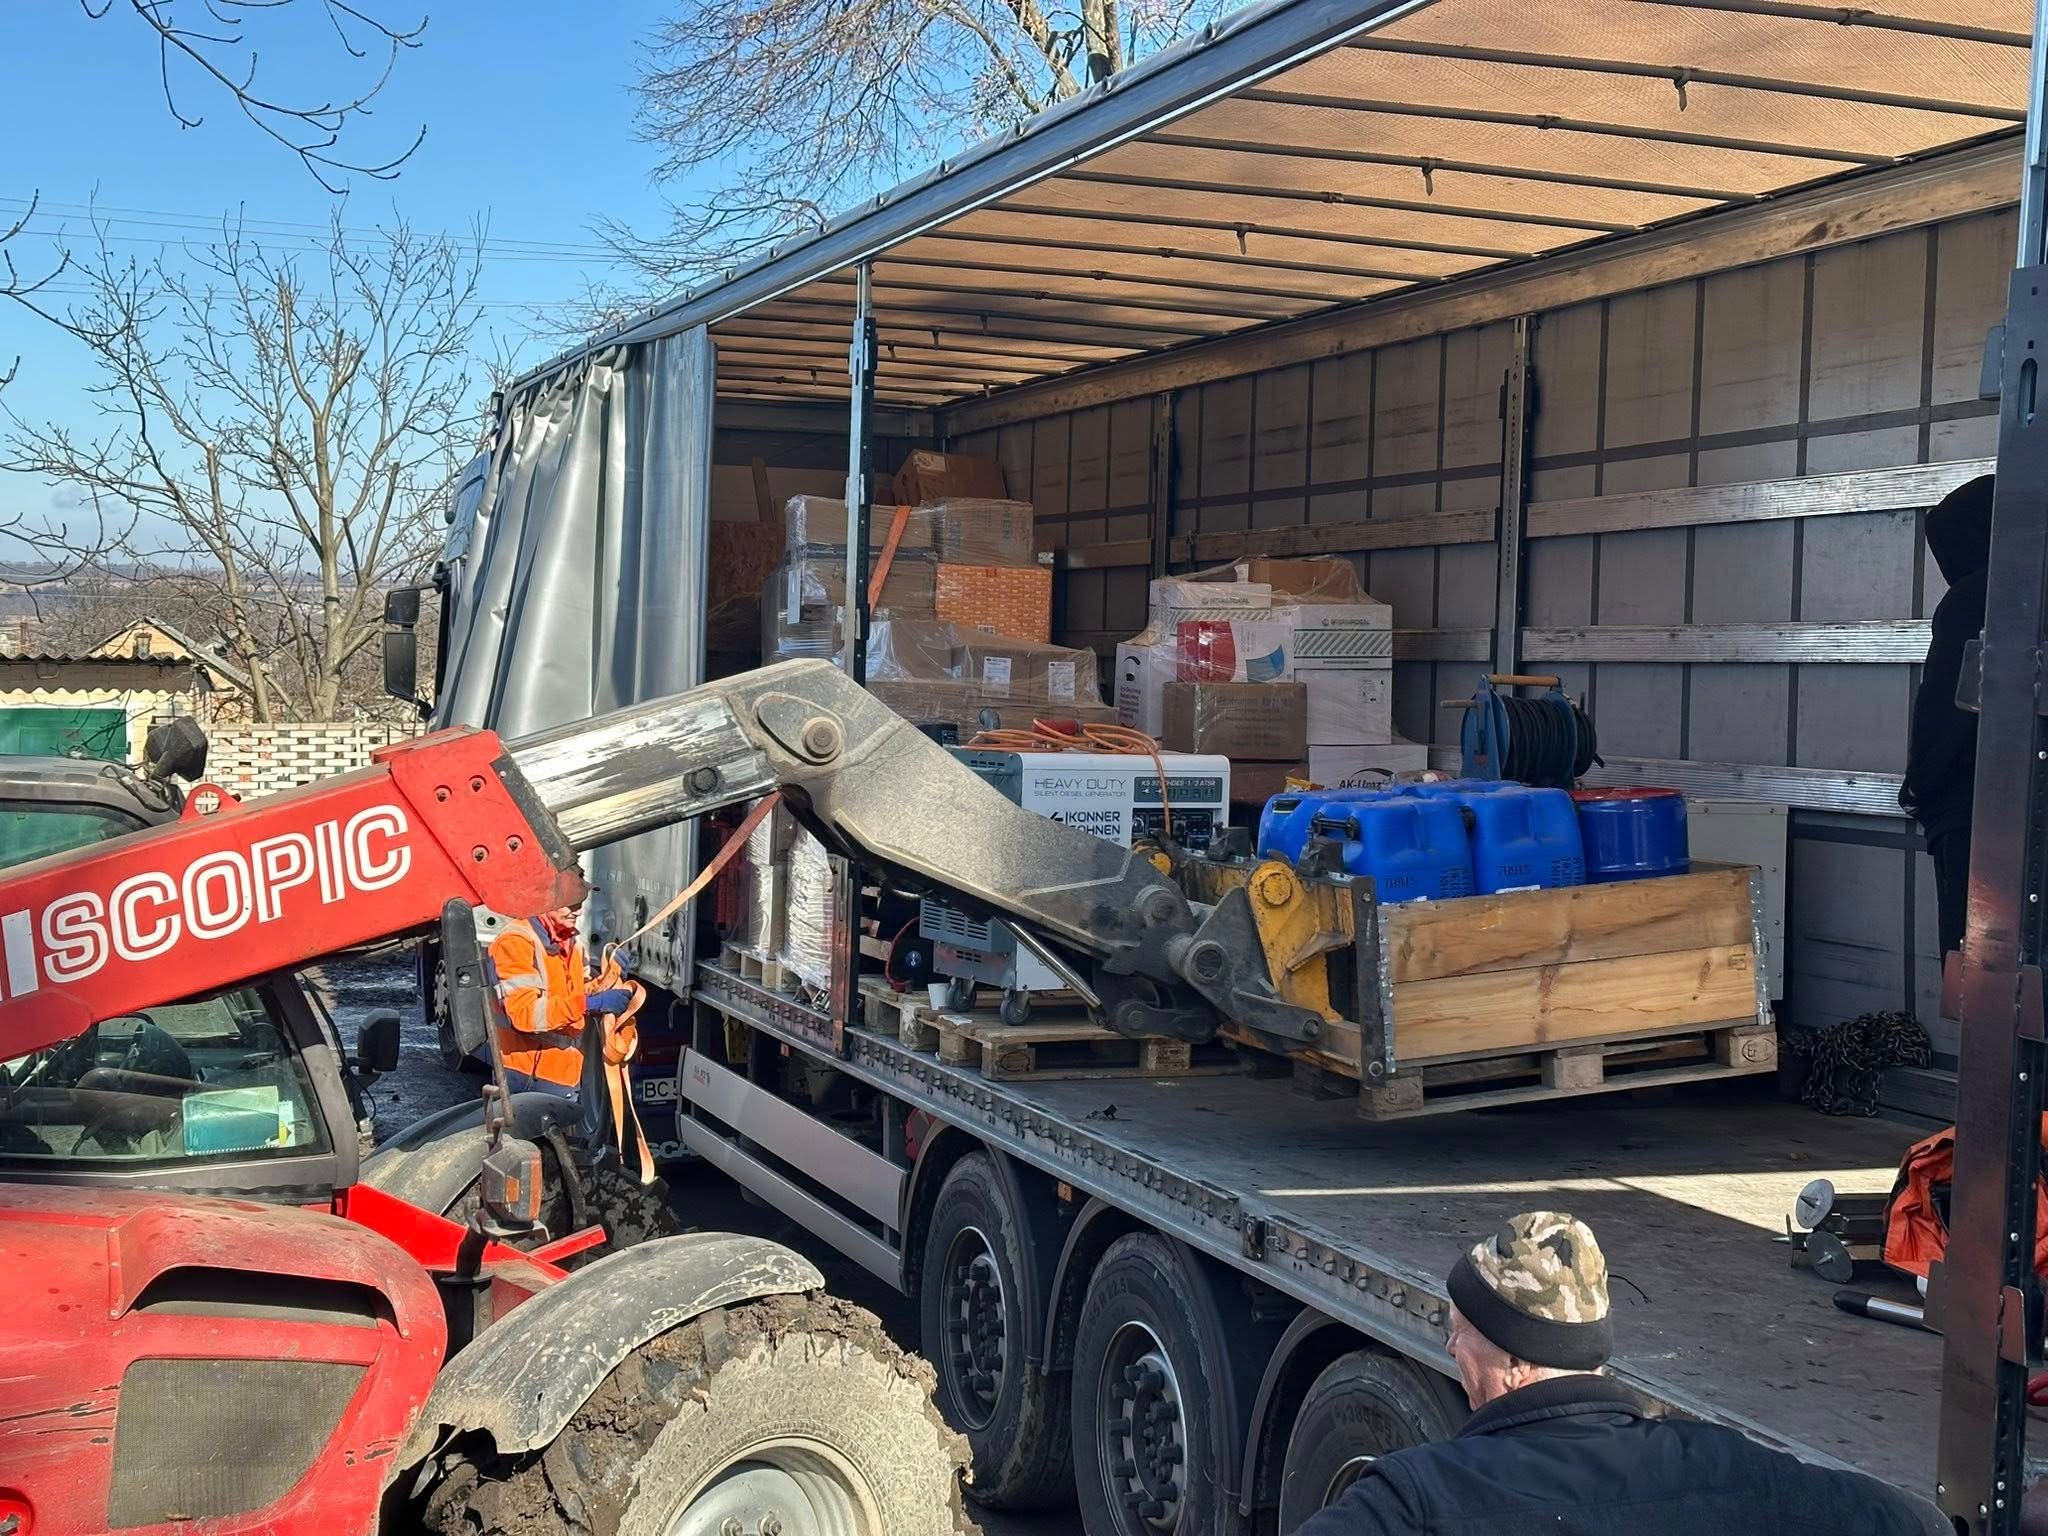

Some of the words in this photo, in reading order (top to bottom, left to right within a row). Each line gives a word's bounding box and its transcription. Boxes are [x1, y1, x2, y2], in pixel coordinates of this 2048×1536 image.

[1034, 778, 1083, 789] HEAVY
[1087, 779, 1127, 790] DUTY
[1069, 824, 1121, 836] OHNEN
[0, 804, 412, 998] ISCOPIC
[645, 1081, 669, 1098] BC
